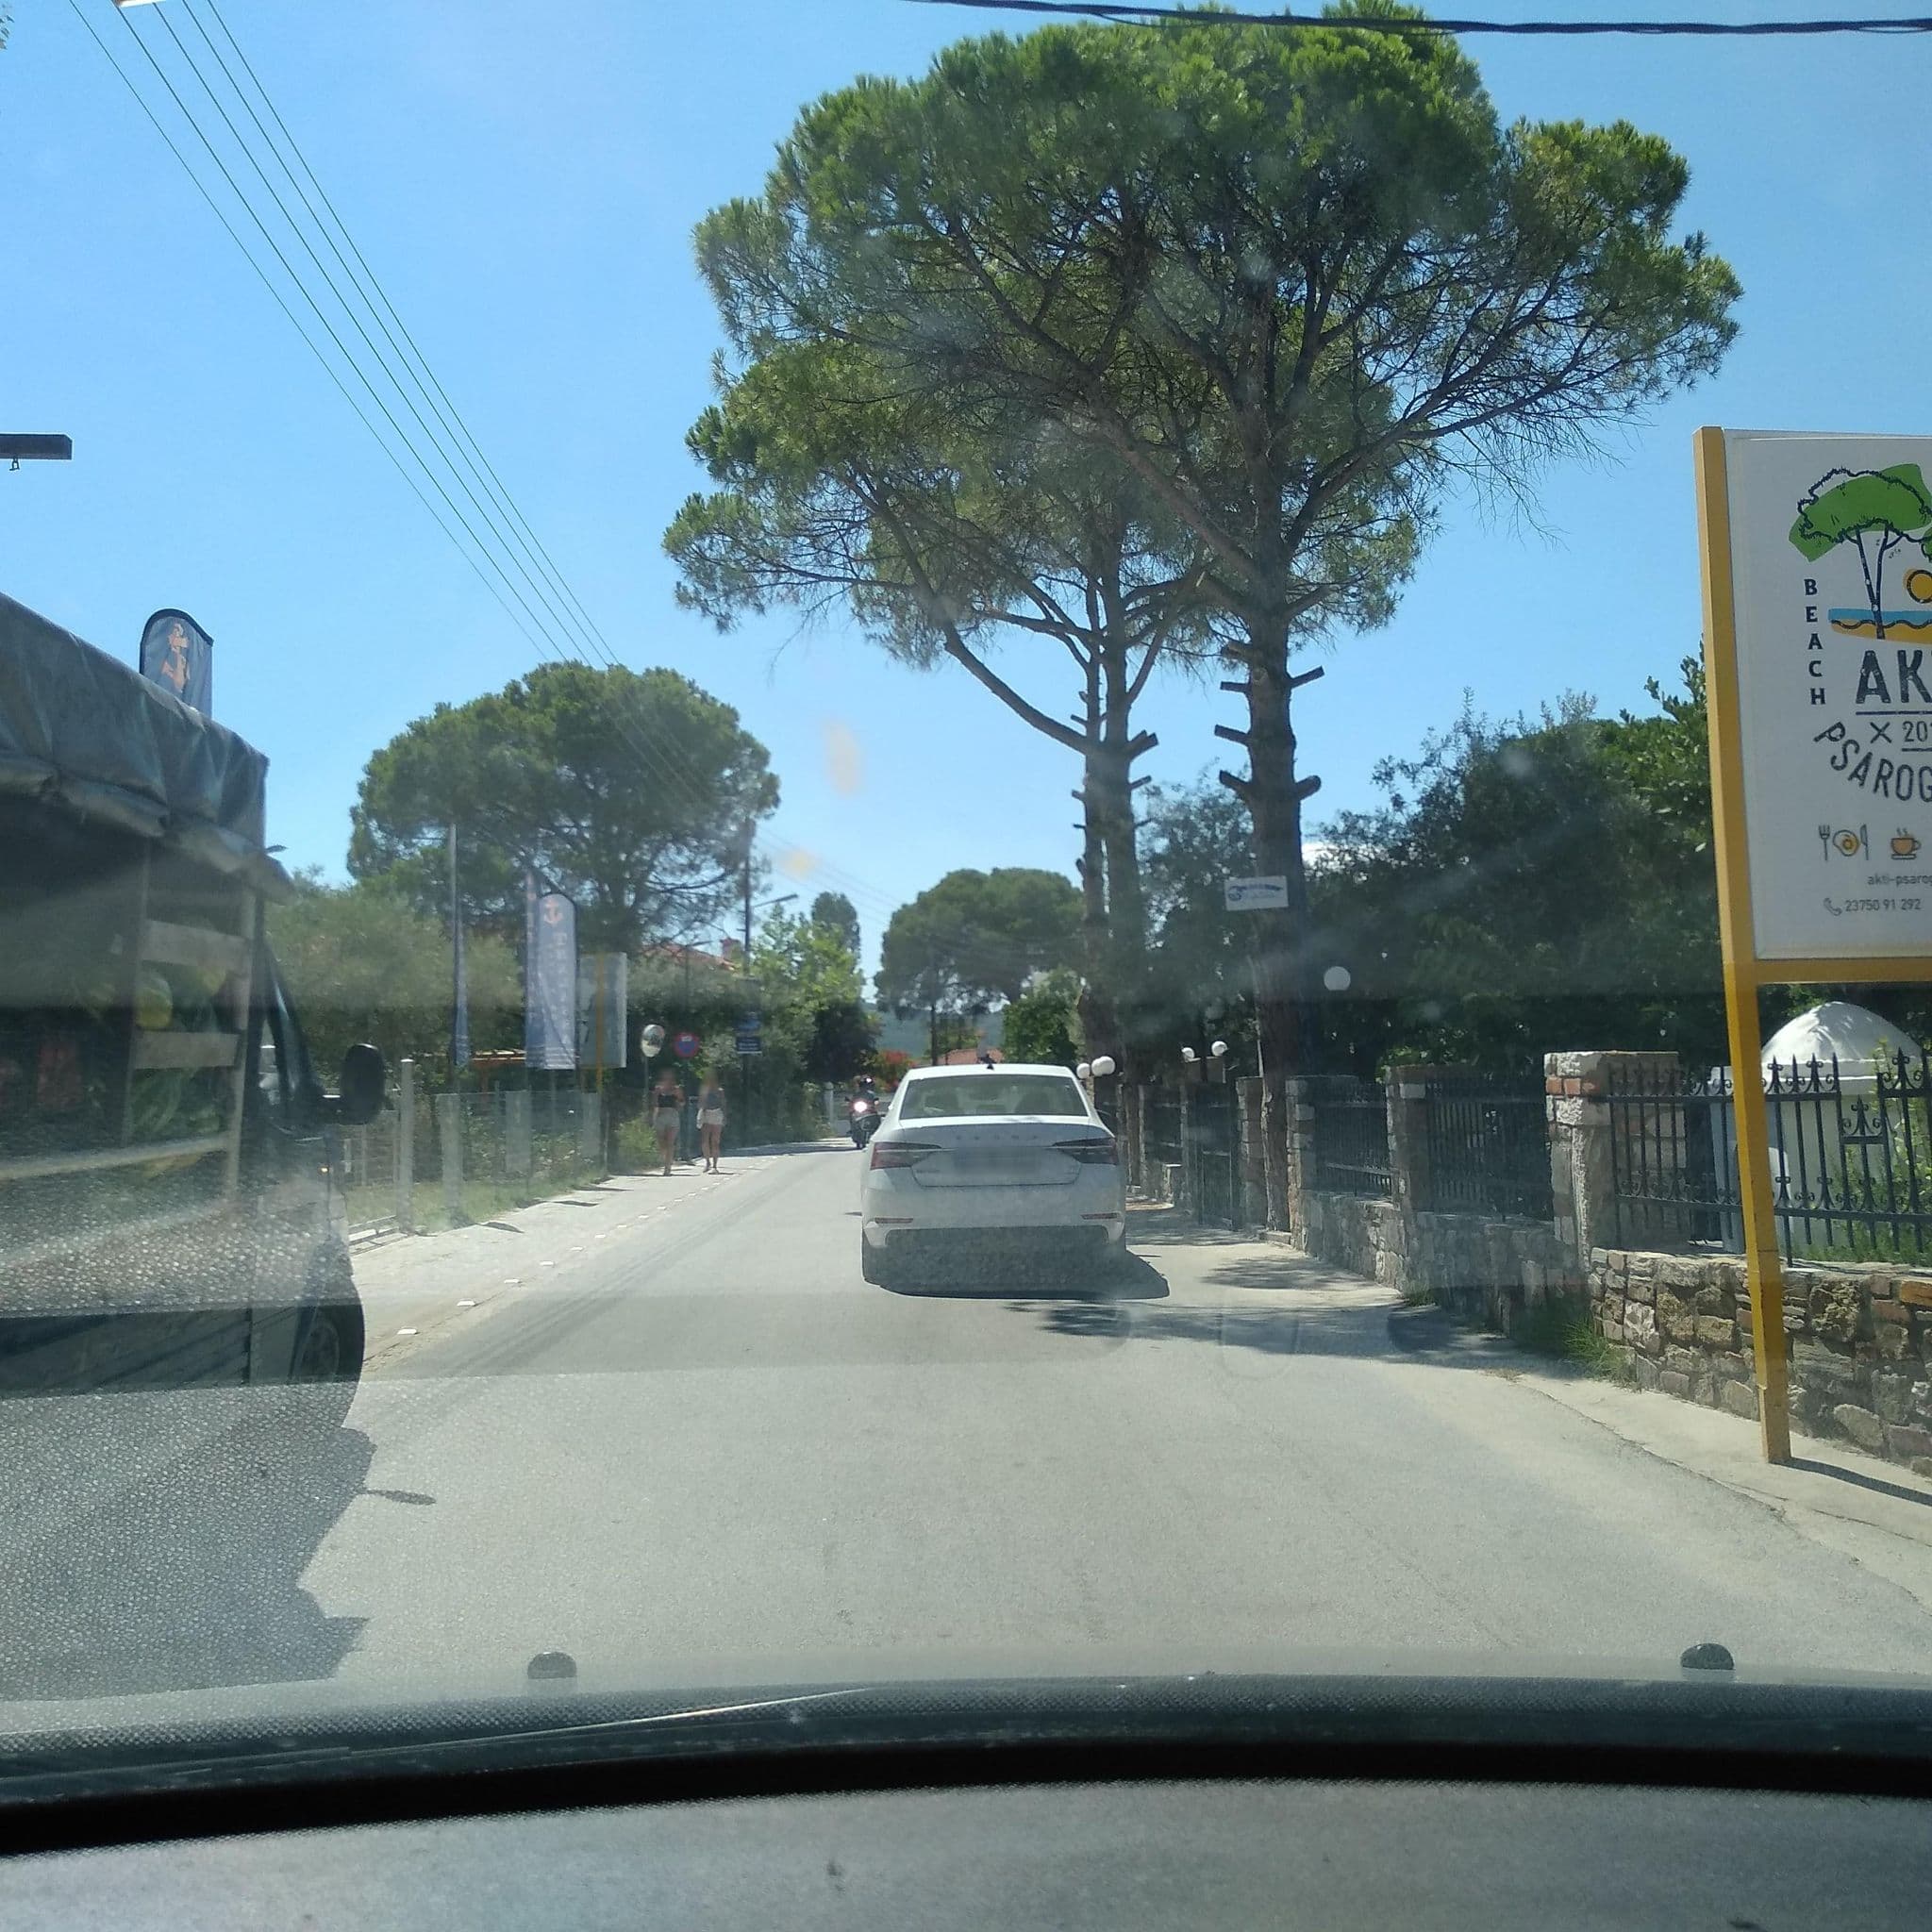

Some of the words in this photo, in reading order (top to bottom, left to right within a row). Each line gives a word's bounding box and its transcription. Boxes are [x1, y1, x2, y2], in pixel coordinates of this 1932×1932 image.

[1804, 578, 1825, 706] BEACH
[1856, 650, 1932, 704] AK
[1902, 720, 1932, 742] 20
[1845, 899, 1879, 912] 23750
[1883, 898, 1895, 911] 91
[1901, 898, 1921, 911] 292
